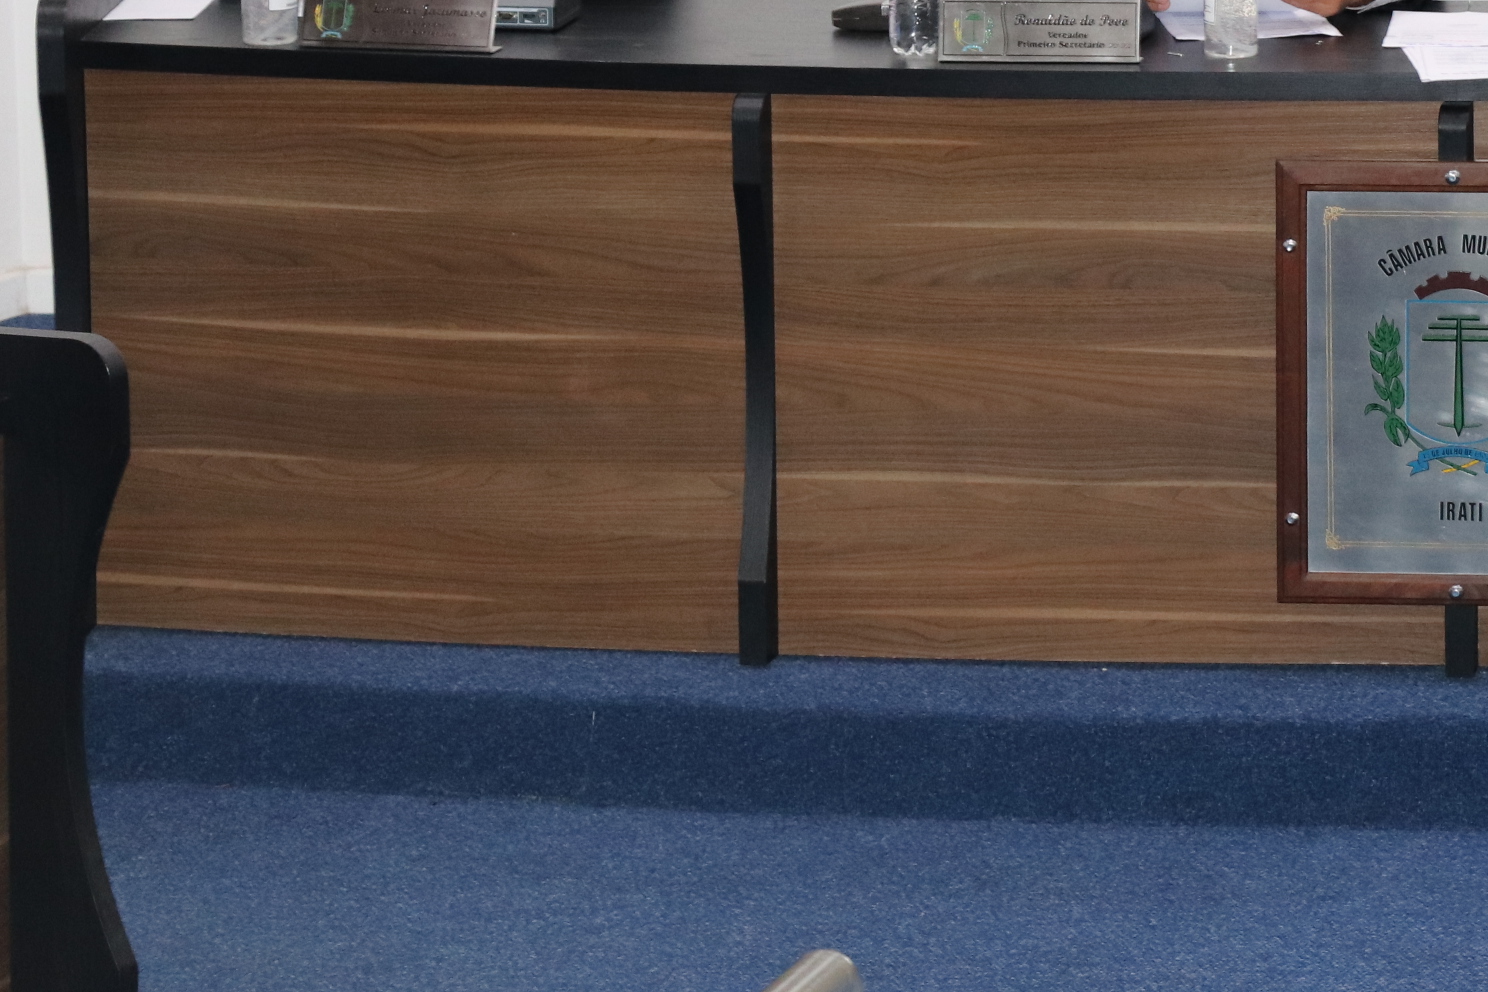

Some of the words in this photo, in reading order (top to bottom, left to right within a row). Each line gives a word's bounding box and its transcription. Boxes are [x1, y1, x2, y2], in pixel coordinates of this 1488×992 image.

[1047, 31, 1088, 39] Vereador
[1017, 40, 1056, 48] Primeiro
[1377, 235, 1448, 277] CÂMARA
[1439, 501, 1483, 522] IRATI
